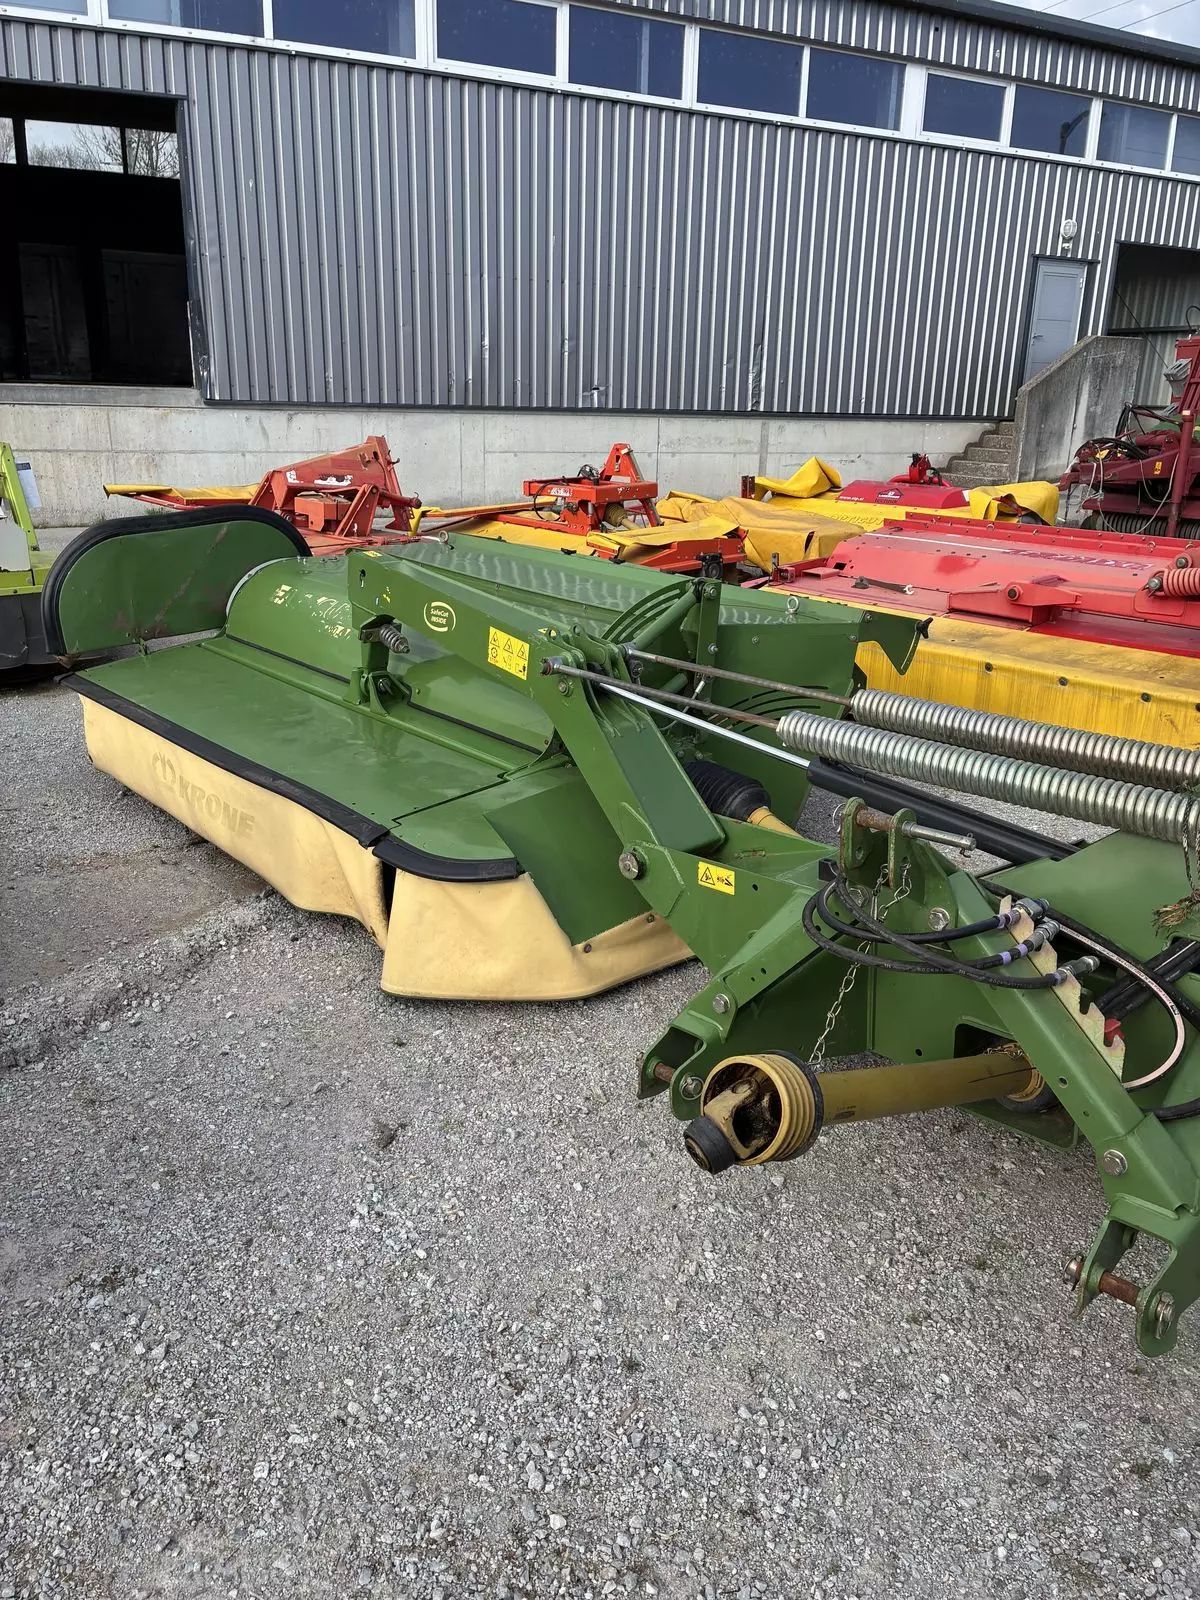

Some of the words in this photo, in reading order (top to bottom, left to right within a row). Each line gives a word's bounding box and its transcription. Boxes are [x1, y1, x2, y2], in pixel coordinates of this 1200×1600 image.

[430, 608, 449, 618] SafeCut
[431, 616, 447, 625] INSIDE
[179, 775, 255, 839] KRONE
